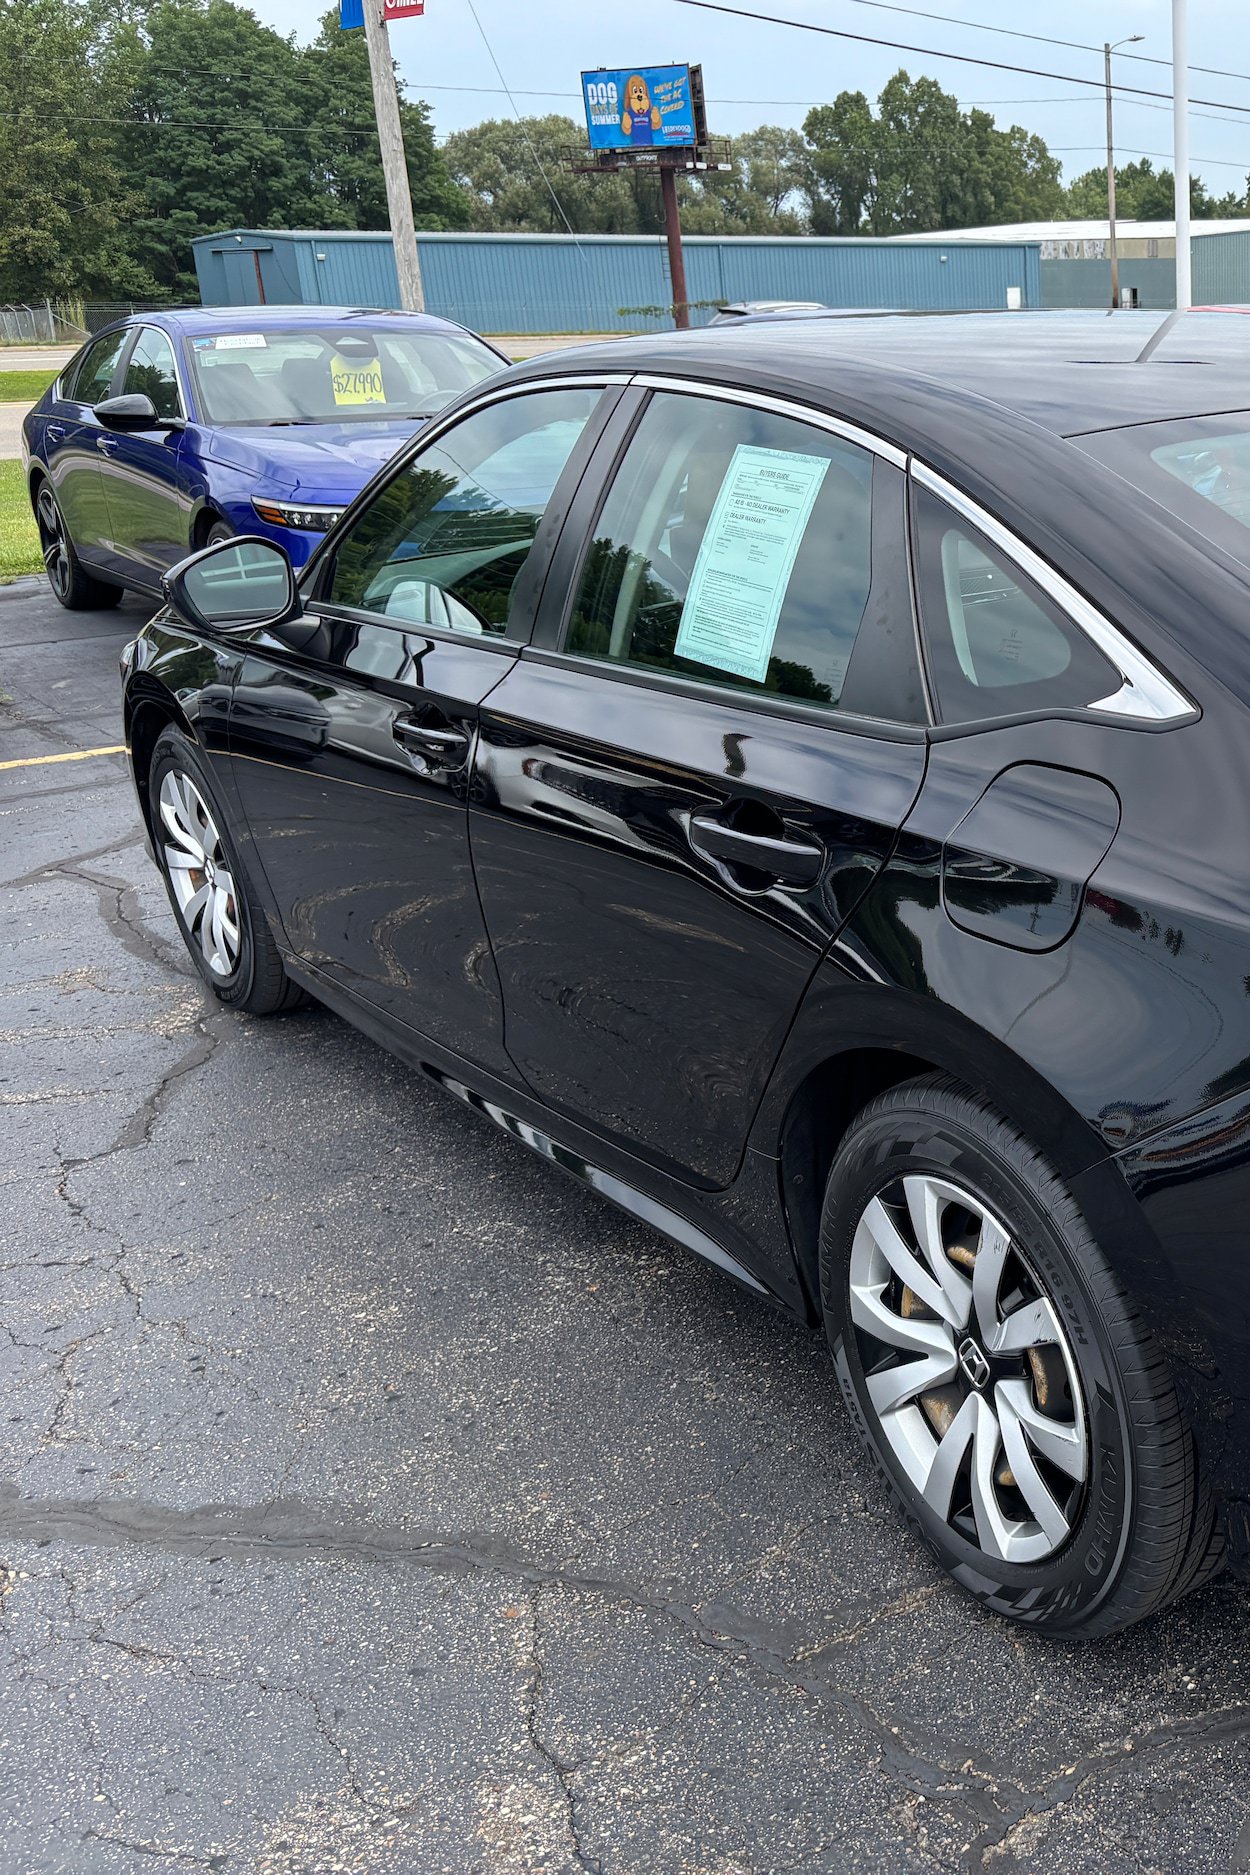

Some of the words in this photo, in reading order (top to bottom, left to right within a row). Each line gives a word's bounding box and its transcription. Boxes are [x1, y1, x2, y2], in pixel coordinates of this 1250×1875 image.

[587, 82, 618, 105] DOG
[591, 114, 621, 126] SUMMER
[752, 501, 768, 511] DEALER
[767, 504, 790, 515] WARRANTY
[729, 512, 744, 520] DEALER
[744, 514, 767, 525] WARRANTY
[1061, 1294, 1089, 1345] 97H
[1084, 1447, 1117, 1577] KUMHO
